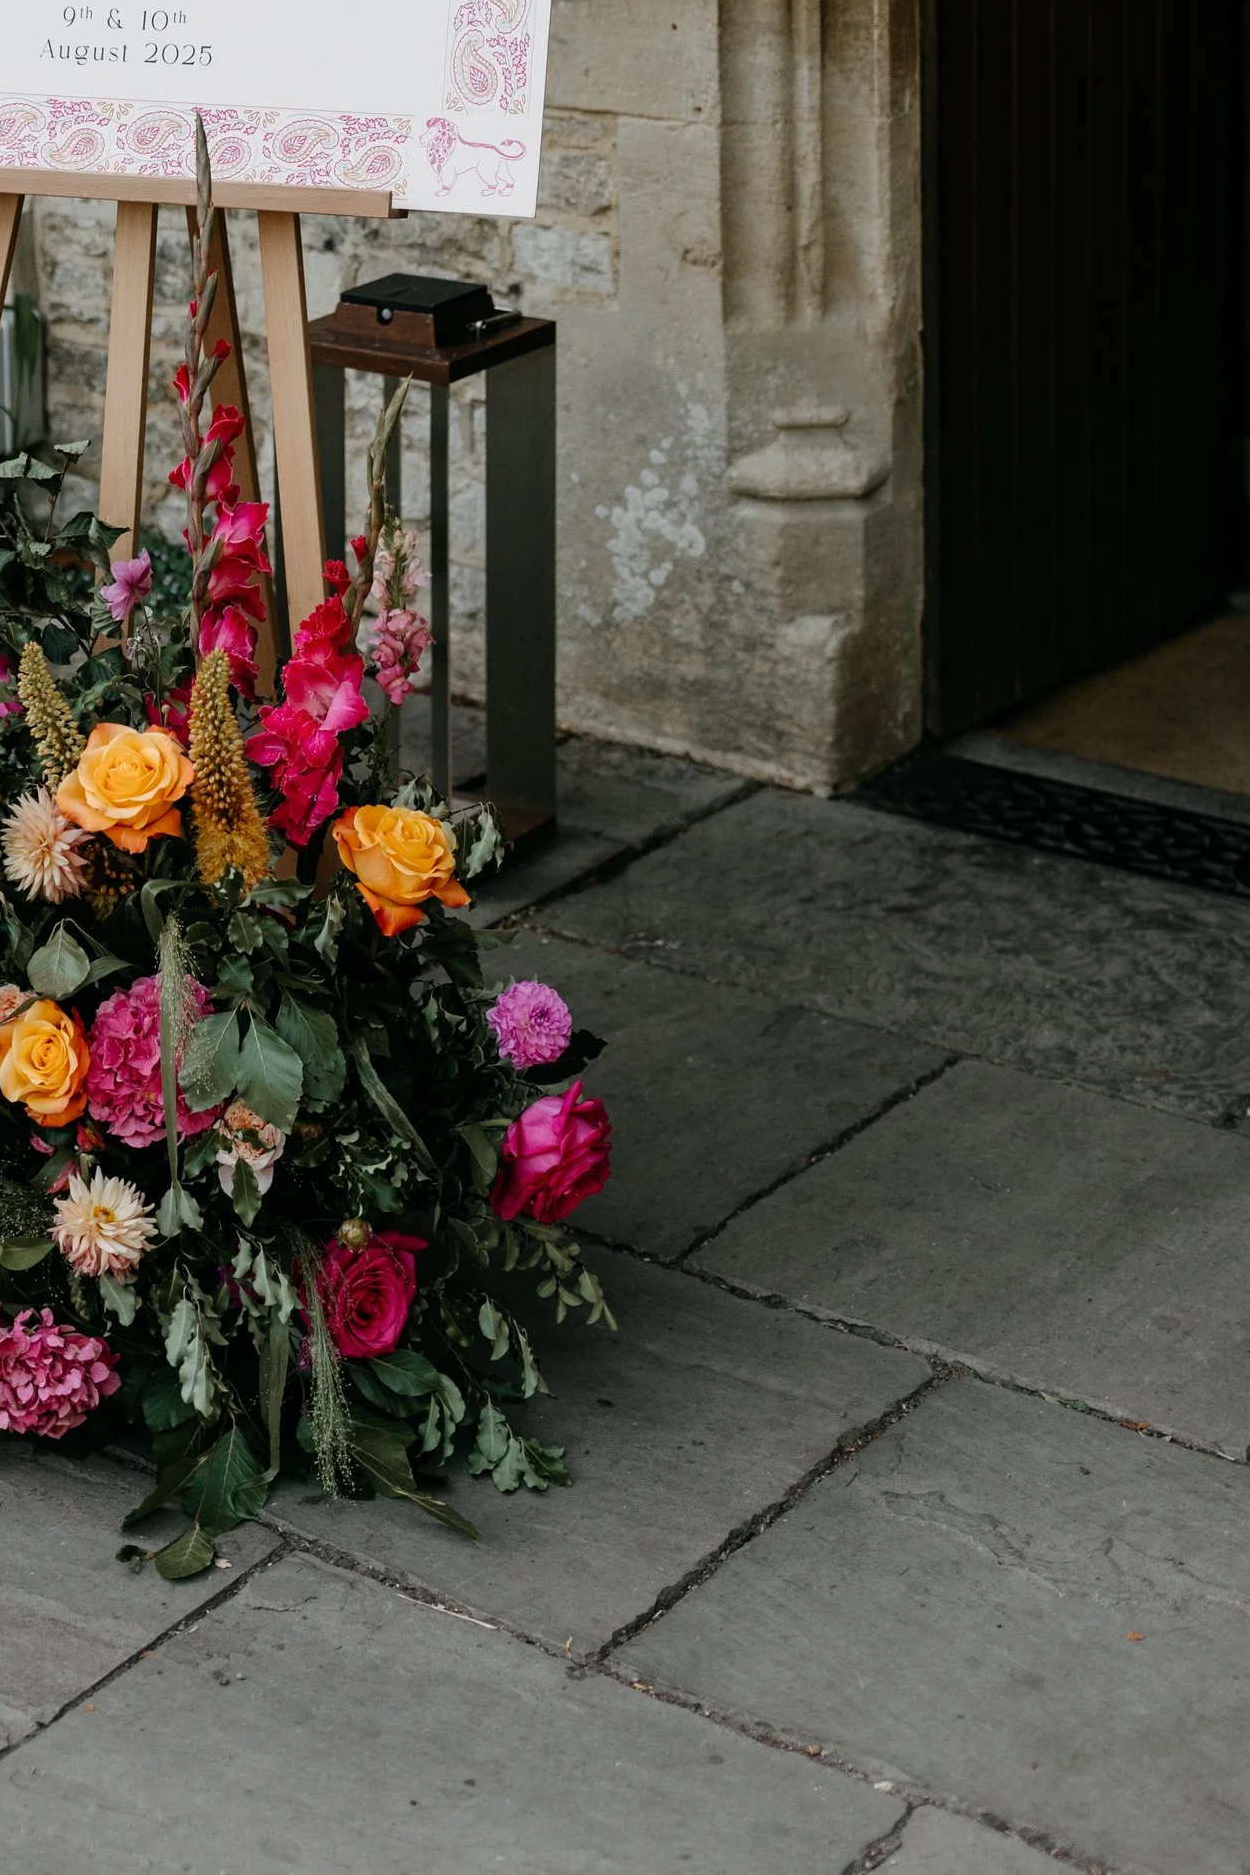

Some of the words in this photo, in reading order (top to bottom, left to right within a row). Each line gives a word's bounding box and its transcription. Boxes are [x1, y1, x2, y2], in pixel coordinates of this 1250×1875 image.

[63, 5, 94, 29] 9th
[106, 8, 125, 30] &
[141, 10, 187, 33] 10th
[39, 38, 128, 67] August
[143, 42, 214, 68] 2025
